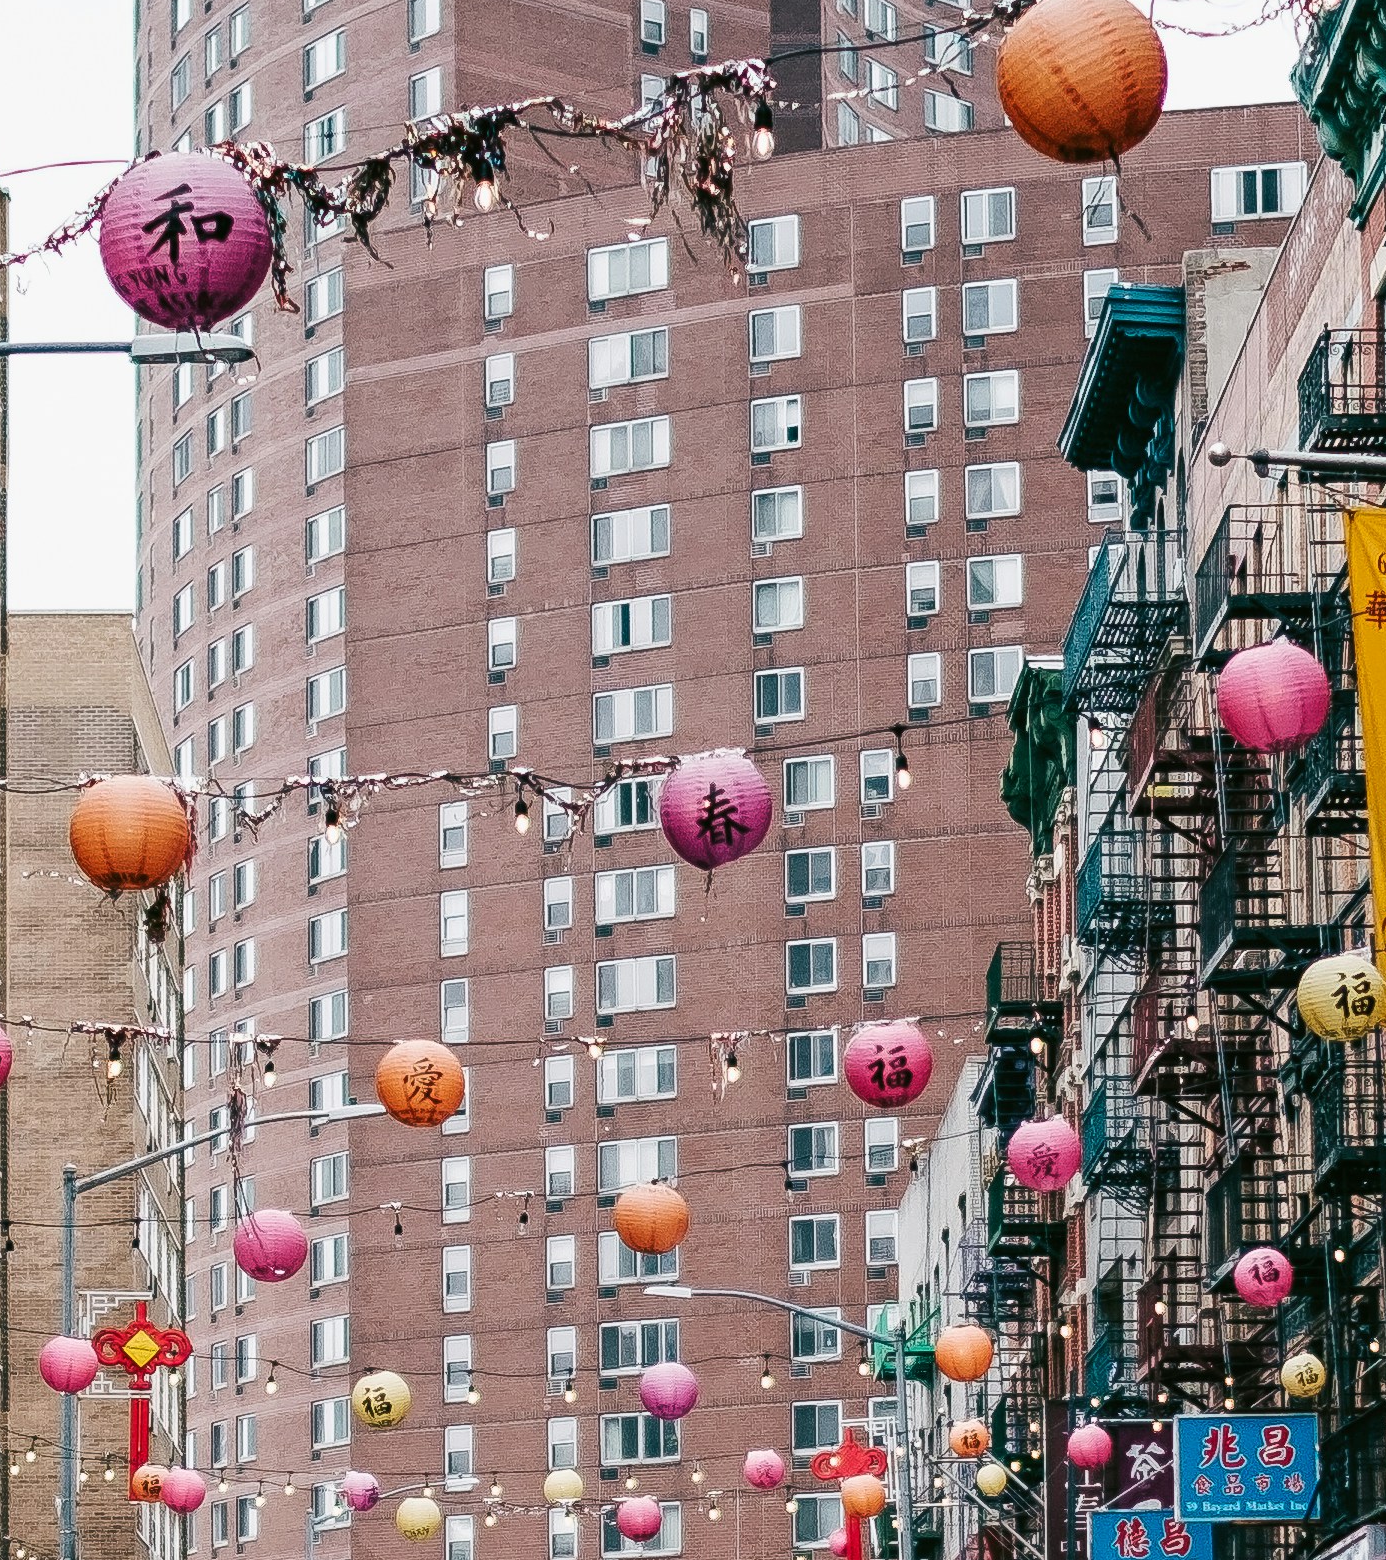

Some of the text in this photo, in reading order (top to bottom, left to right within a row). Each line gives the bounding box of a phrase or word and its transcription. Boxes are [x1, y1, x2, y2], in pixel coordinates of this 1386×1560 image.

[142, 184, 233, 266] 和
[696, 782, 751, 845] 春
[1331, 972, 1375, 1020] 福
[401, 1056, 443, 1106] 愛
[869, 1043, 912, 1091] 福
[1251, 1259, 1280, 1286] 福
[1294, 1362, 1320, 1387] 福
[362, 1386, 393, 1418] 福
[1198, 1423, 1296, 1470] 兆昌
[142, 1478, 161, 1496] 福
[1193, 1472, 1306, 1496] 食品市場
[1202, 1501, 1241, 1514] Bayard
[1246, 1500, 1285, 1512] Market
